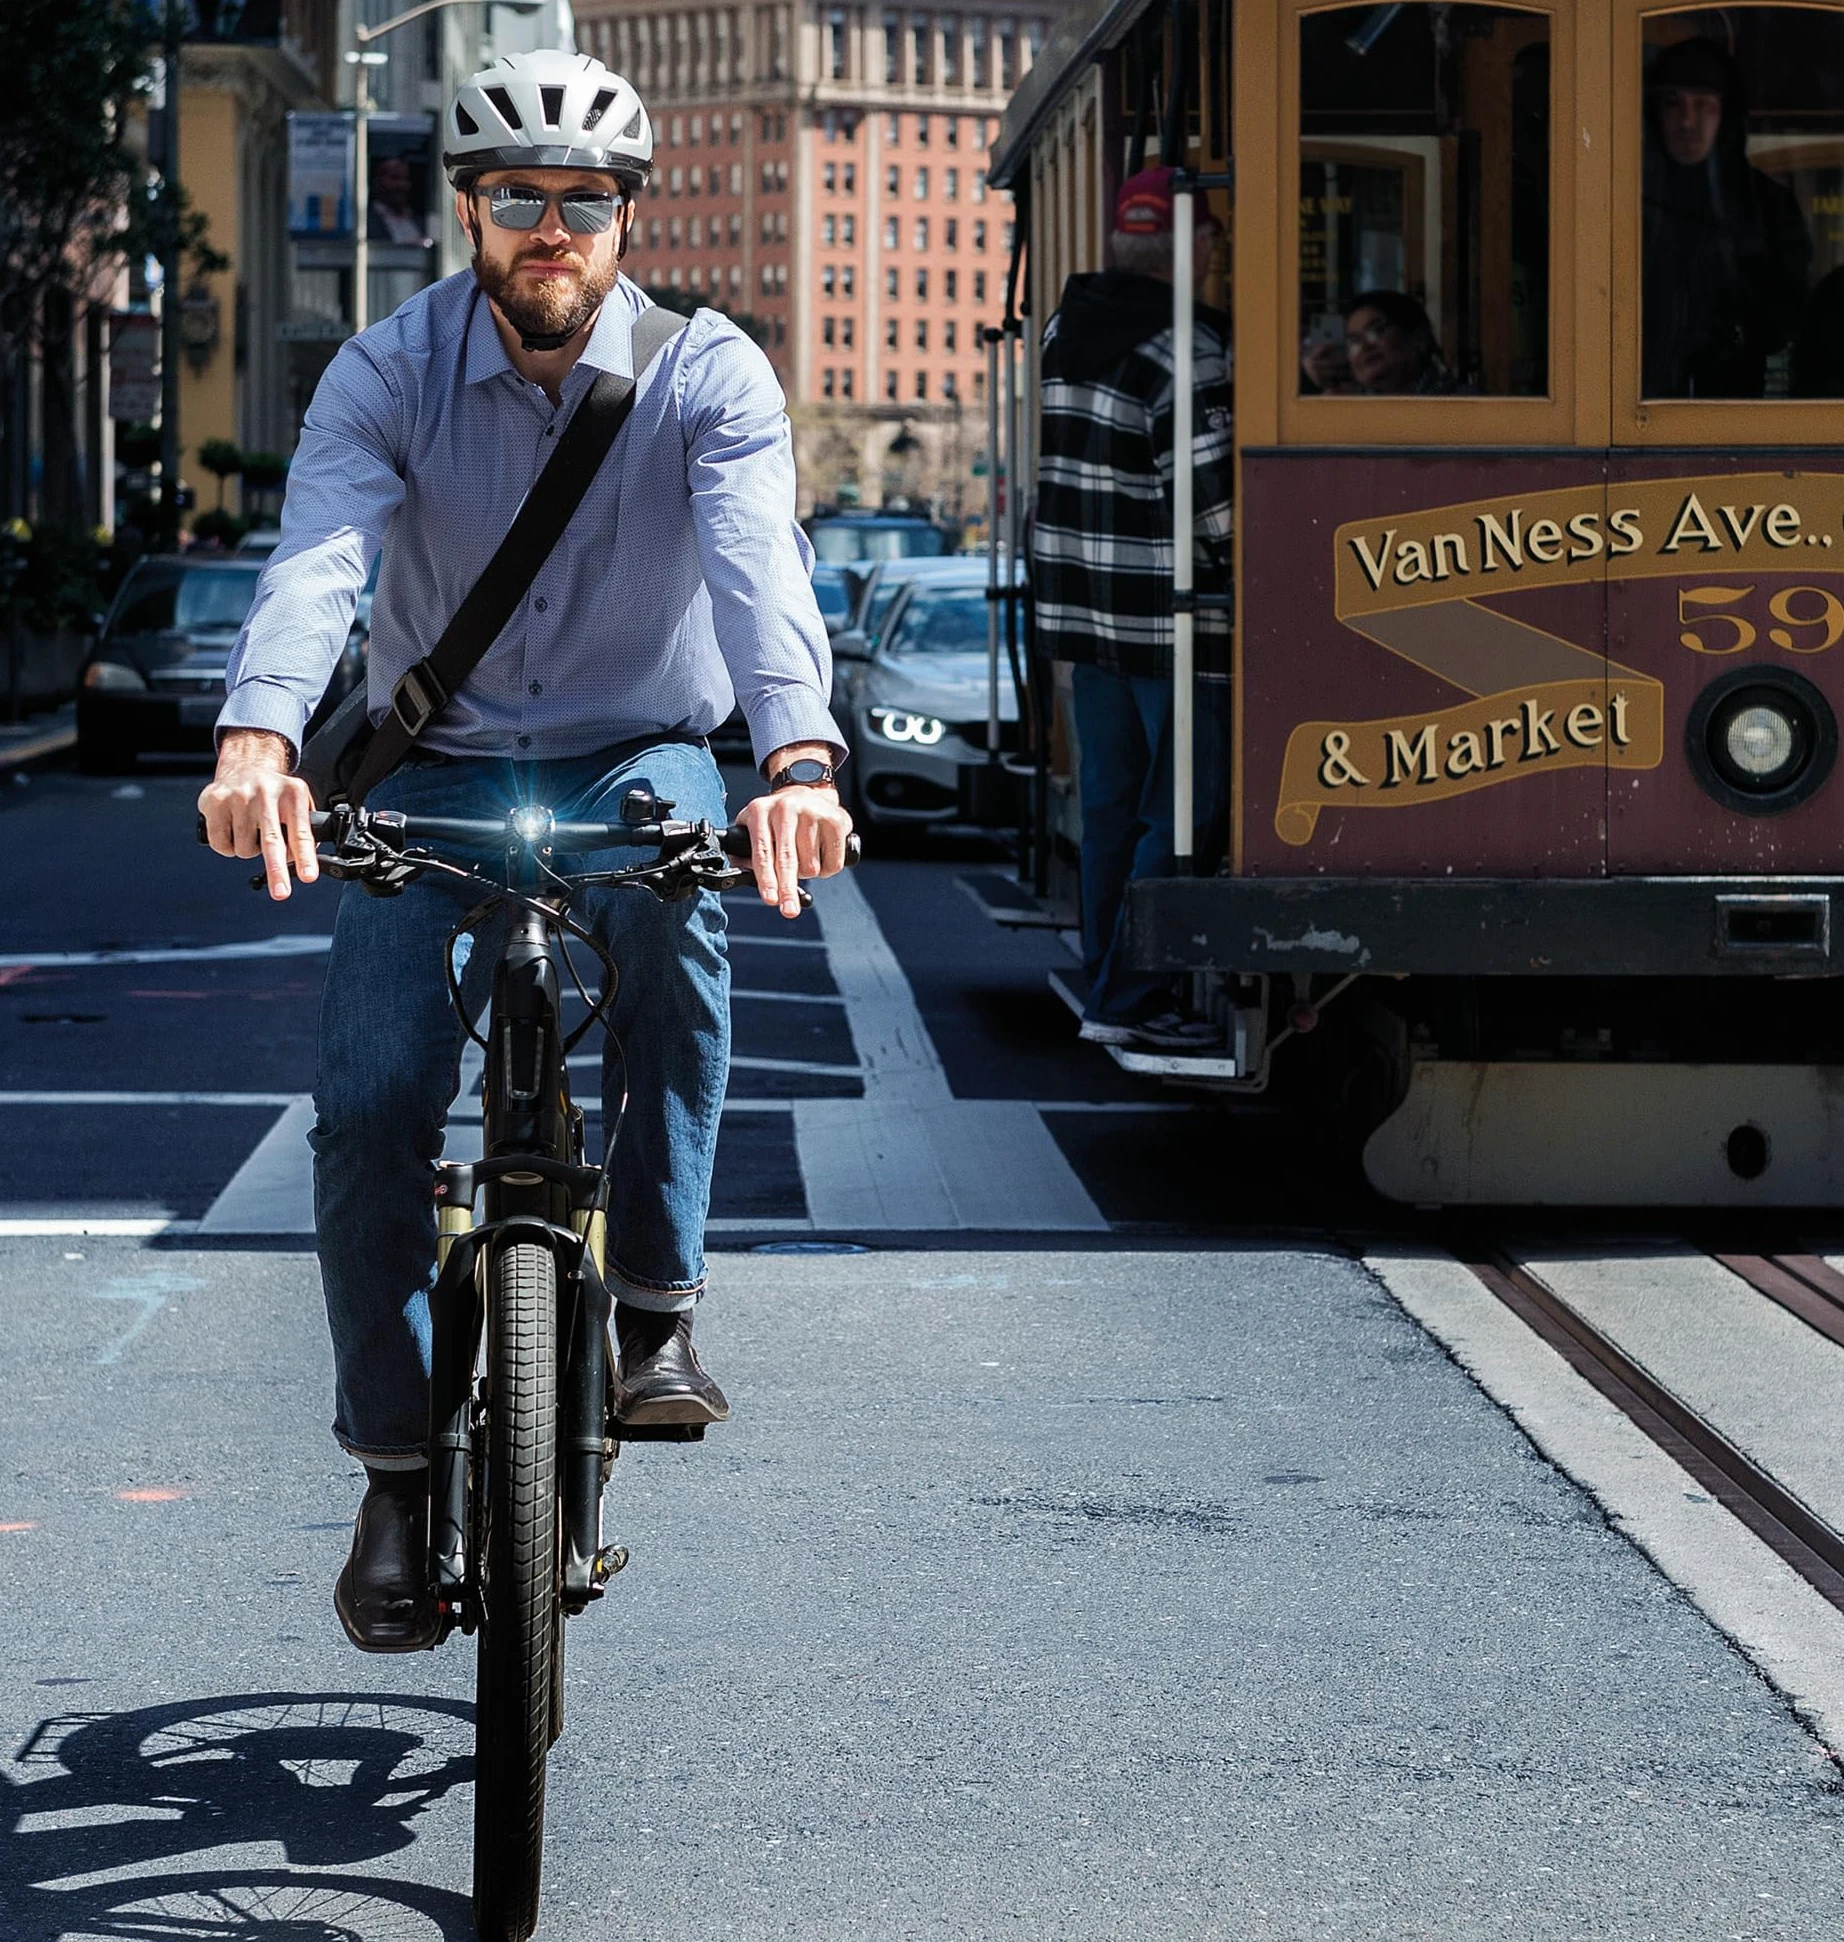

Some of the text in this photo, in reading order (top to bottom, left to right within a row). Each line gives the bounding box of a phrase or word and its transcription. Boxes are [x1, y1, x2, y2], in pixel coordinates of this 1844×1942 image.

[1348, 528, 1470, 591] Van
[1475, 508, 1645, 572] Ness
[1676, 584, 1844, 656] 59
[1317, 692, 1632, 789] & Market
